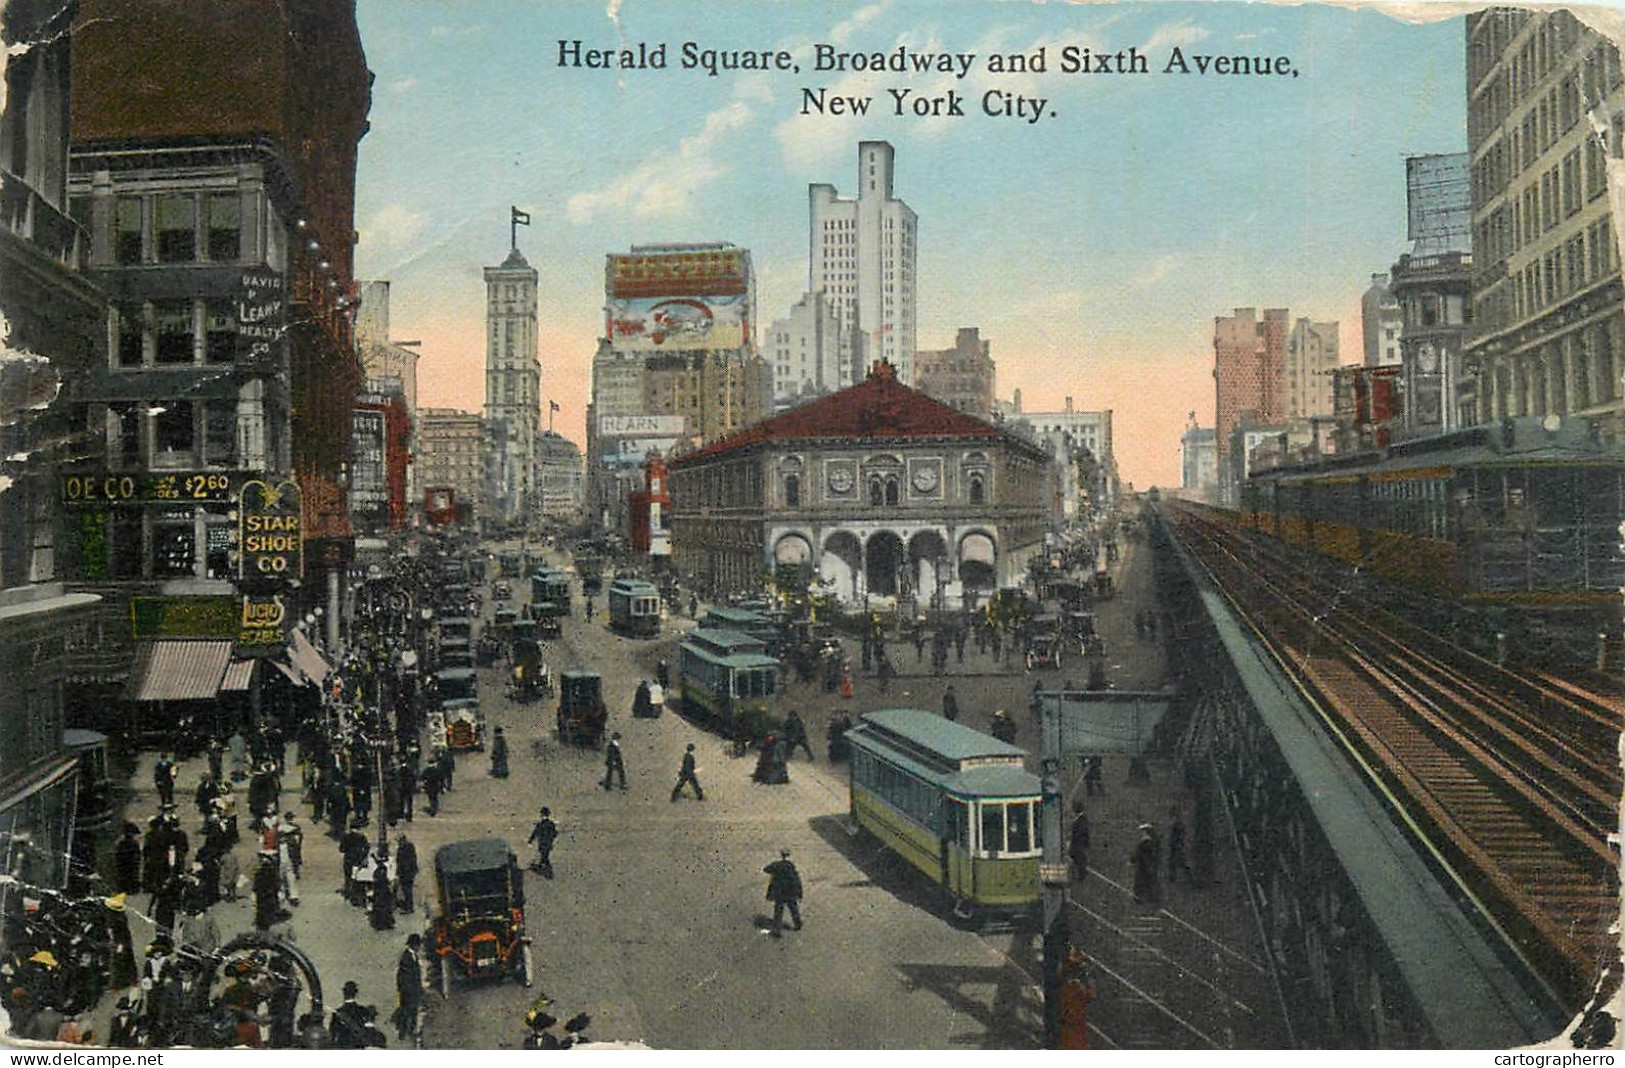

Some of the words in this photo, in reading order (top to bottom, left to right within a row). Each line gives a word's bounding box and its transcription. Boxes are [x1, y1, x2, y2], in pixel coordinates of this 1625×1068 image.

[242, 275, 281, 288] DAVID
[604, 416, 659, 432] HEARN
[104, 476, 134, 499] CO
[185, 475, 228, 498] $260
[246, 515, 298, 531] STAR
[246, 535, 299, 552] SHOE
[257, 556, 287, 573] CO
